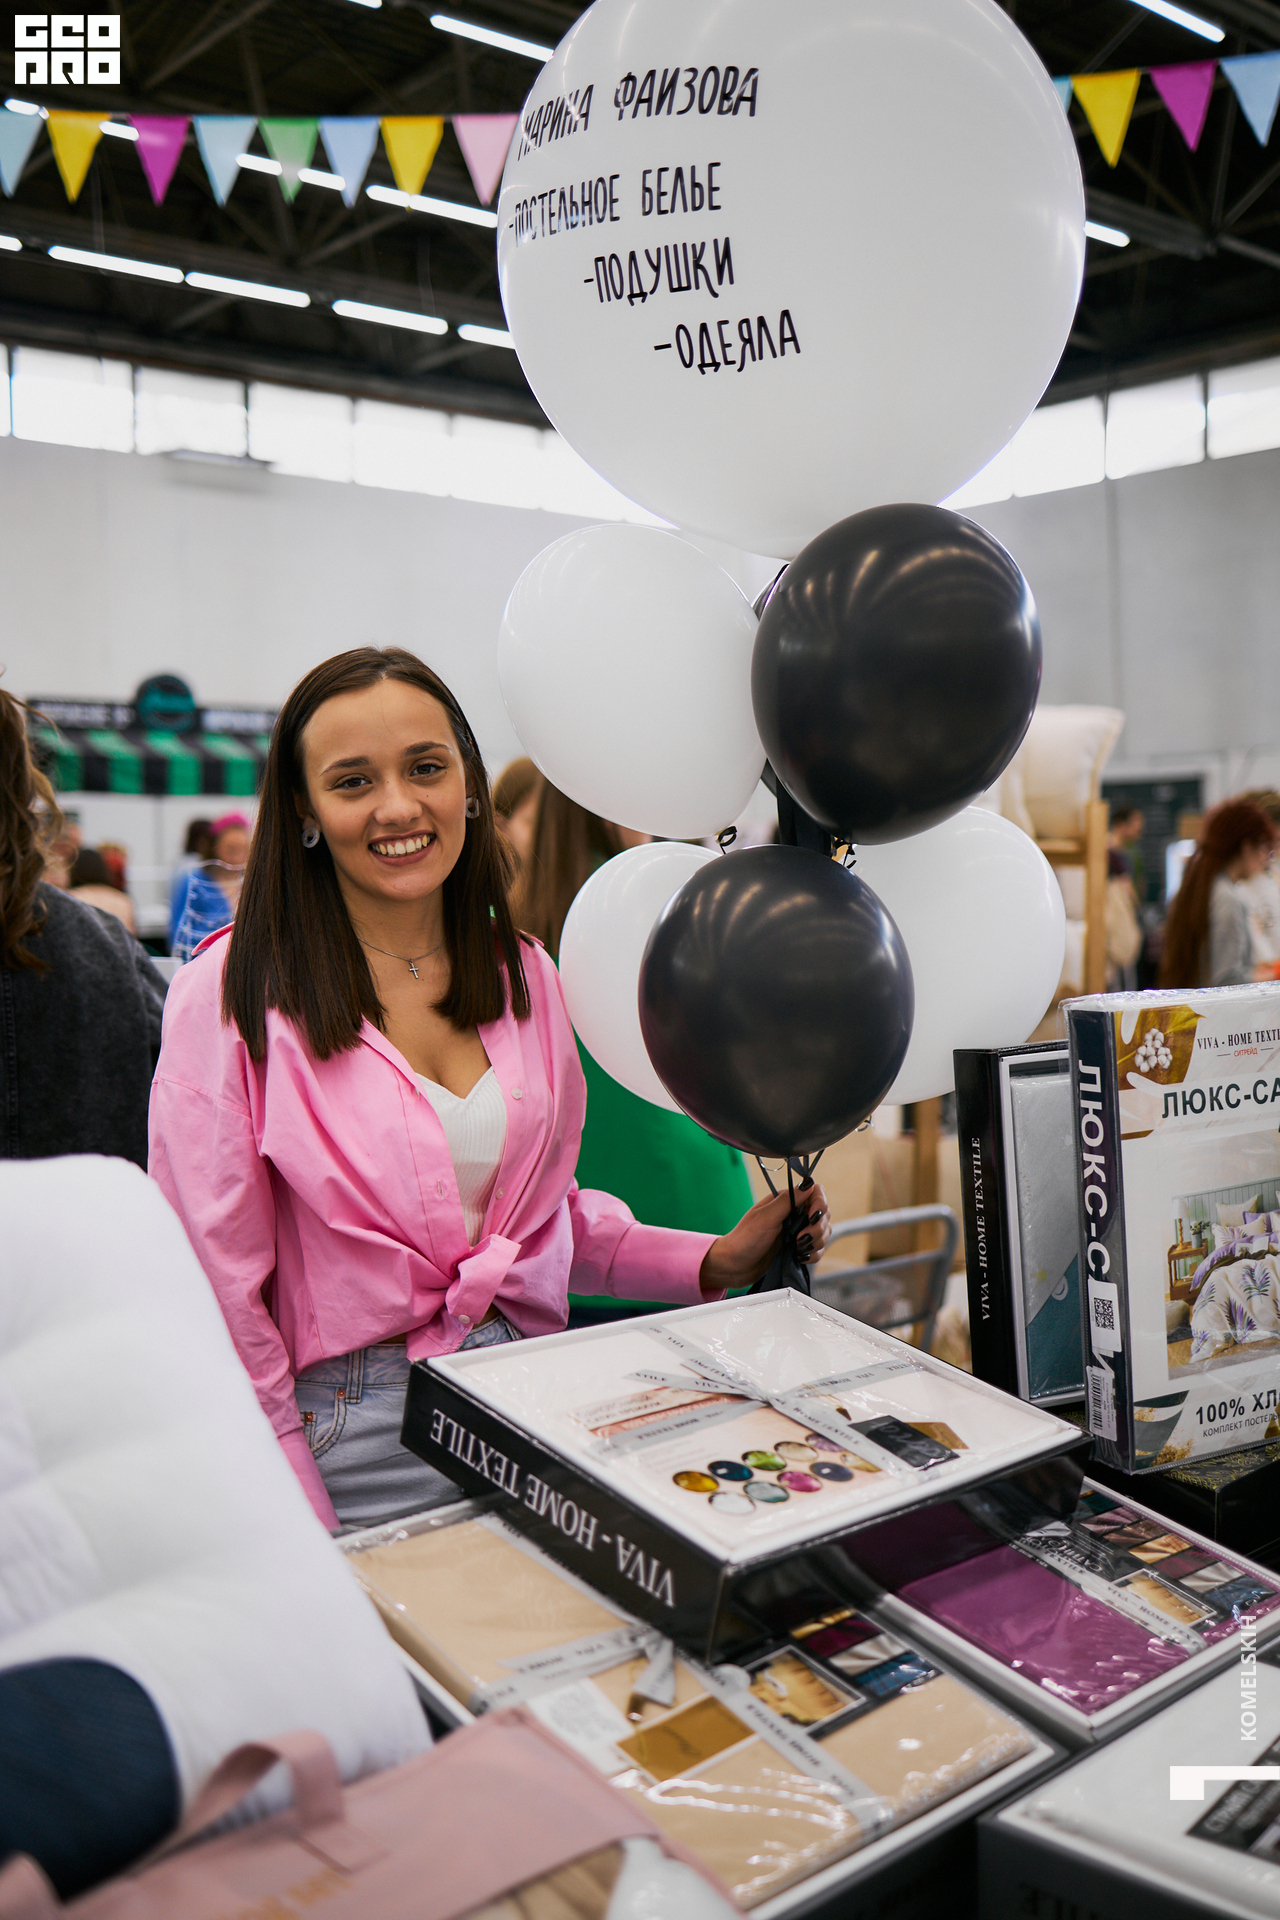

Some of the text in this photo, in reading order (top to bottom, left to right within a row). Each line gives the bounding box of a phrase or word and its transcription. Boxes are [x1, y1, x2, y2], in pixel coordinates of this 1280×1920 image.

[613, 66, 759, 121] ФАИЗОВА
[641, 162, 722, 217] БЕЛЬЕ
[1197, 1036, 1219, 1050] VIVA
[1227, 1032, 1253, 1047] HOME
[971, 1138, 984, 1212] TEXTILE
[976, 1216, 988, 1269] HOME
[981, 1281, 991, 1320] VIVA
[1196, 1396, 1245, 1425] 100%
[1203, 1420, 1243, 1438] КОМПЛЕКТ
[430, 1408, 521, 1499] TEXTILE
[524, 1473, 600, 1552] HOME
[616, 1533, 676, 1608] VIVA
